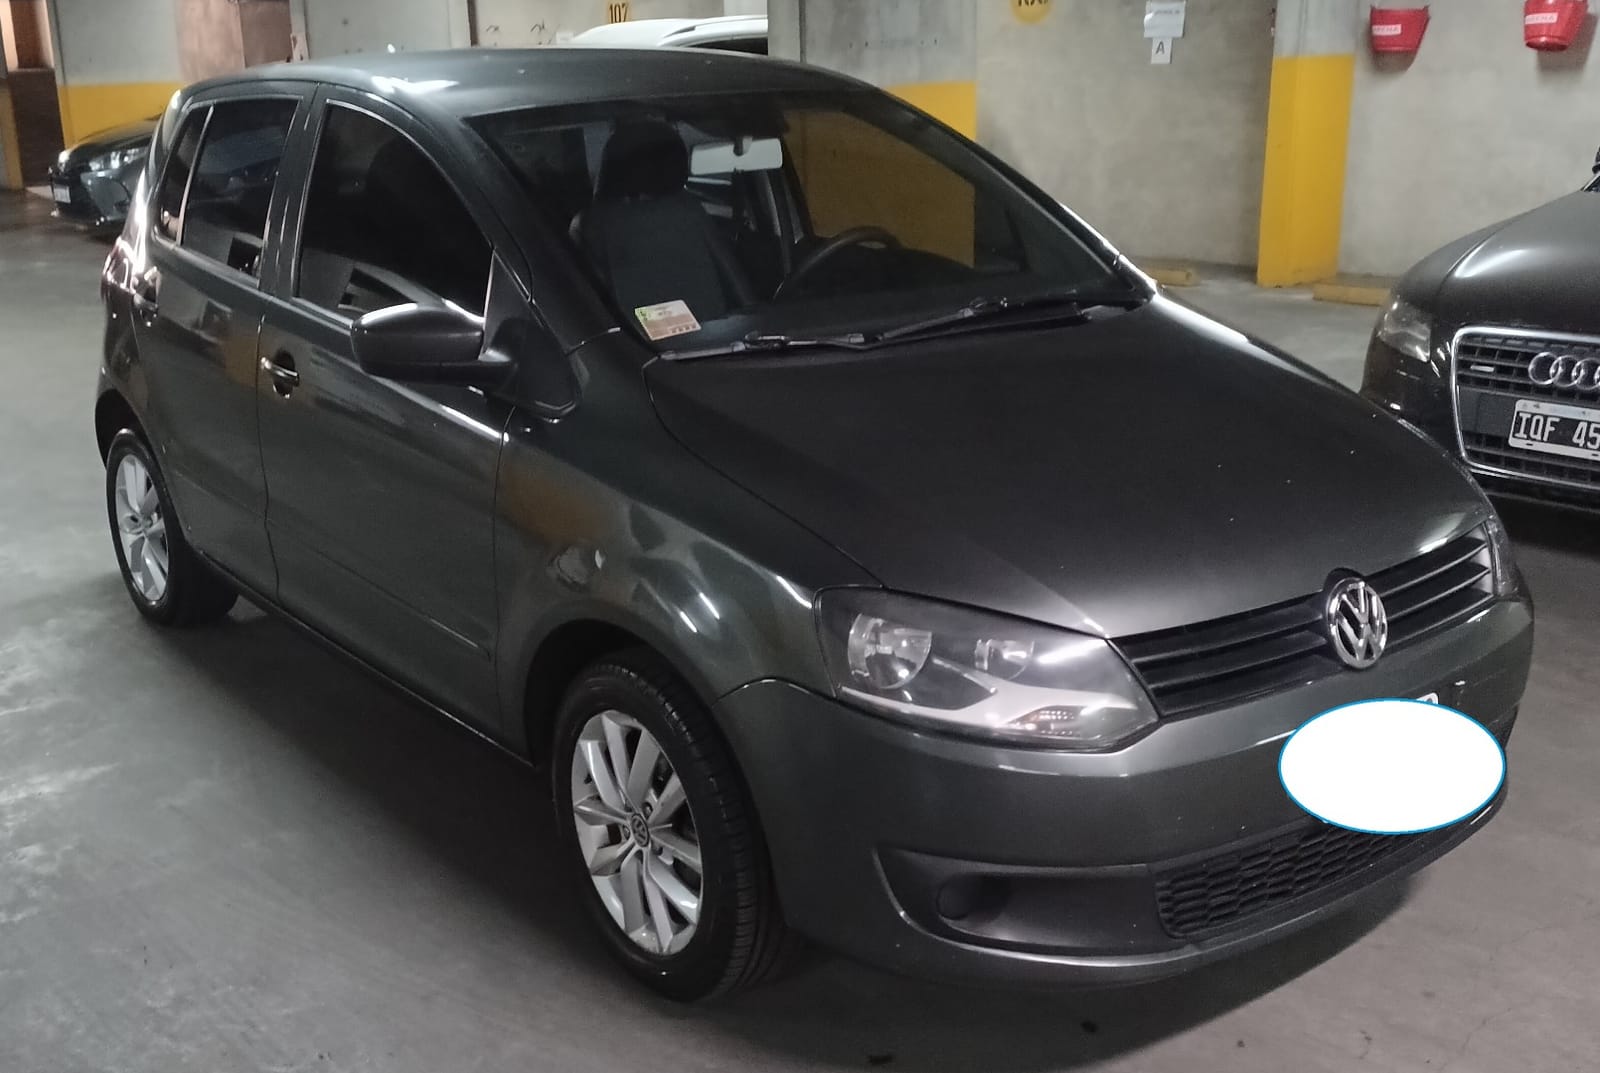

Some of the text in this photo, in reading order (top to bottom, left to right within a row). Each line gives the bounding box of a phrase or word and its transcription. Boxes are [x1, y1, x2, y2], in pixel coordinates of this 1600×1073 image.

[609, 3, 628, 24] 107
[1155, 41, 1165, 55] A
[1514, 412, 1560, 442] IQF
